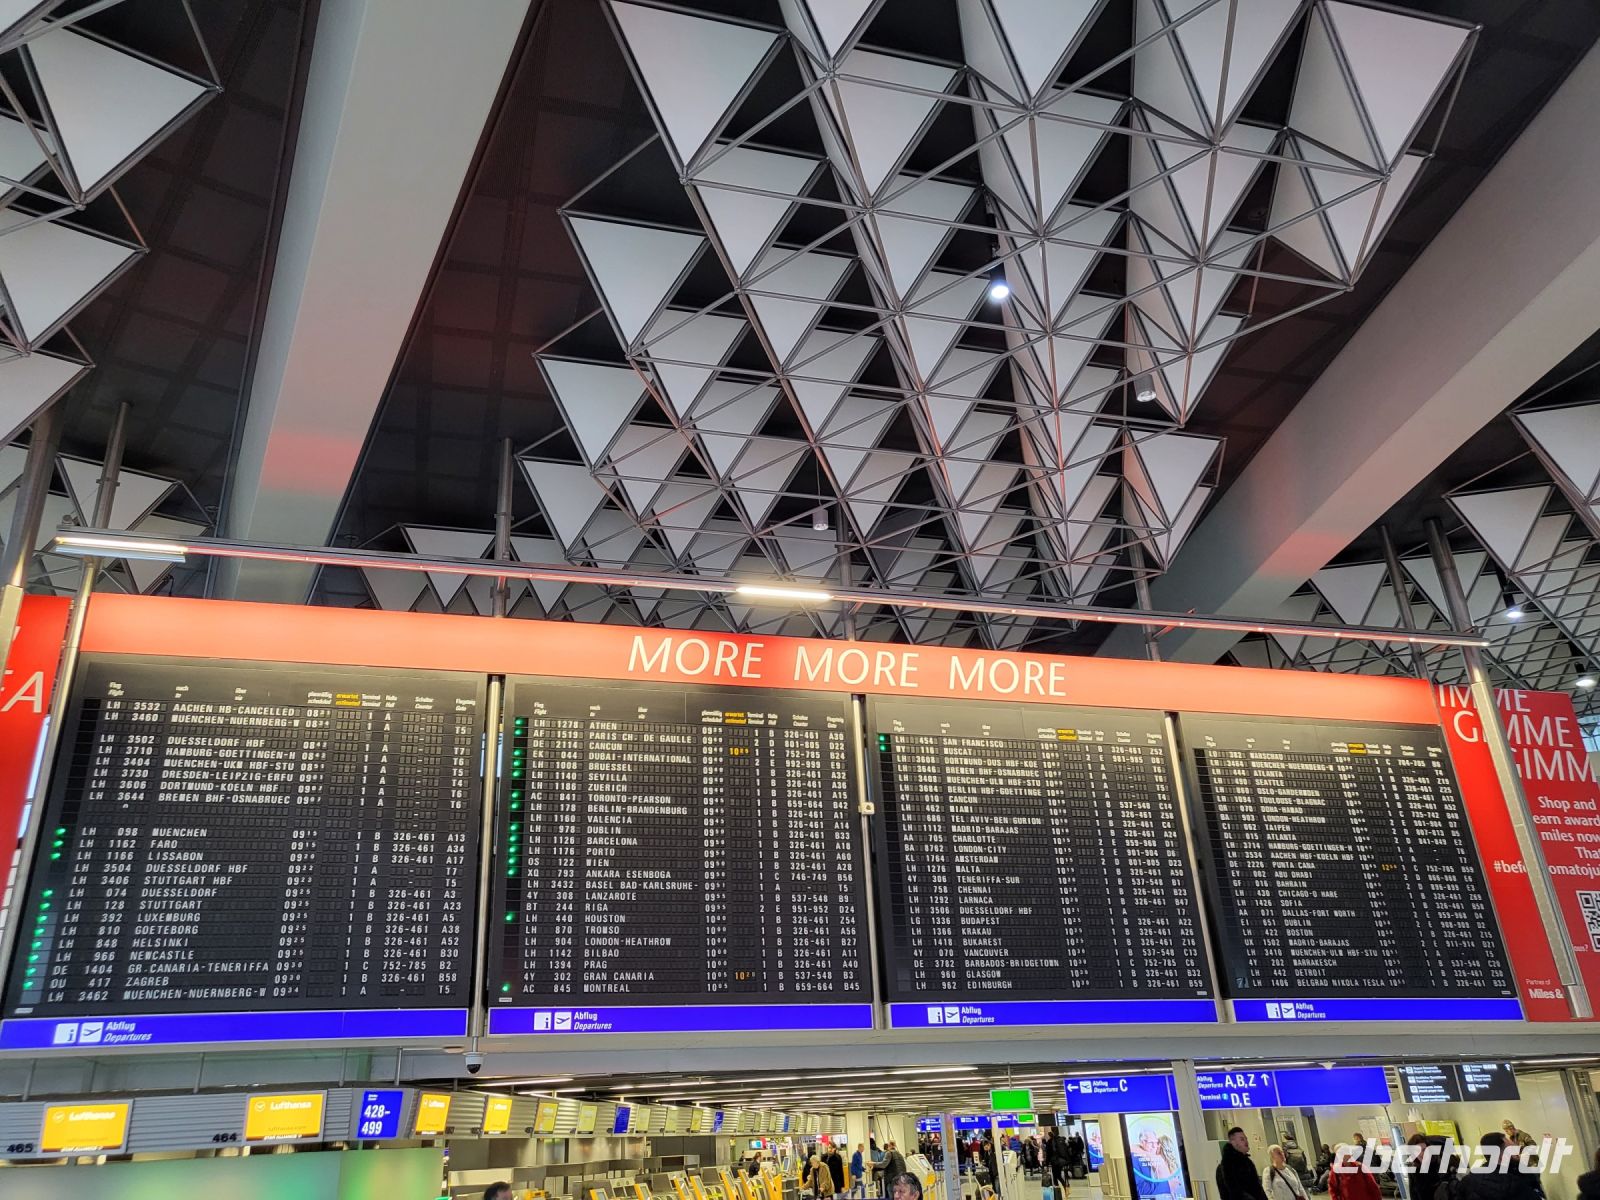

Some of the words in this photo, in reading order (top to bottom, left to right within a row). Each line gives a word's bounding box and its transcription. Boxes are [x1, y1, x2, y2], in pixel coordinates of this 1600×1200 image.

[628, 635, 764, 679] MORE
[794, 645, 920, 688] MORE
[949, 655, 1067, 697] MORE
[172, 704, 212, 712] AACHEN
[218, 706, 295, 716] HB-CANCELLED
[590, 722, 616, 730] ATHEN
[1453, 710, 1574, 748] GMME
[167, 737, 239, 746] DUESSELDORF
[589, 753, 691, 763] DUBAI-INTERNATIONAL
[588, 794, 670, 803] TORONTO-PEARSON
[1537, 796, 1570, 813] Shop
[1573, 798, 1597, 811] and
[588, 805, 686, 814] BERLIN-BRANDENBURG
[587, 815, 631, 823] VALENCIA
[1533, 814, 1561, 825] earn
[150, 828, 206, 836] MUENCHEN
[1541, 828, 1575, 842] miles
[148, 840, 177, 848] FARO
[587, 837, 637, 845] BARCELONA
[146, 852, 202, 860] LISSABON
[142, 876, 205, 884] STUTTGART
[585, 892, 636, 900] LANZAROTE
[138, 901, 202, 909] STUTTGART
[585, 903, 608, 911] RIGA
[135, 913, 200, 921] LUXEMBURG
[133, 926, 198, 934] GOETEBORG
[131, 938, 189, 947] HELSINKI
[584, 937, 670, 945] LONDON-HEATHROW
[129, 951, 194, 960] NEWCASTLE
[583, 972, 606, 980] GRAN
[613, 972, 653, 980] CANARIA
[124, 977, 169, 986] ZAGREB
[583, 984, 629, 992] MONTREAL
[1529, 989, 1555, 998] Miles
[1555, 989, 1564, 998] &
[961, 1006, 982, 1015] Abflug
[1295, 1002, 1314, 1011] Abflug
[574, 1011, 598, 1021] Abflug
[962, 1015, 995, 1024] Departures
[1297, 1011, 1326, 1019] Departures
[106, 1021, 136, 1032] Abflug
[574, 1021, 612, 1031] Departures
[104, 1031, 152, 1043] Departures
[1225, 1073, 1256, 1088] A,B,Z
[1119, 1079, 1128, 1092] C
[1231, 1092, 1251, 1107] D,E
[270, 1101, 312, 1111] Lufthansa
[364, 1105, 391, 1118] 428-
[361, 1121, 383, 1135] 499
[212, 1133, 237, 1143] 464
[7, 1143, 34, 1154] 465
